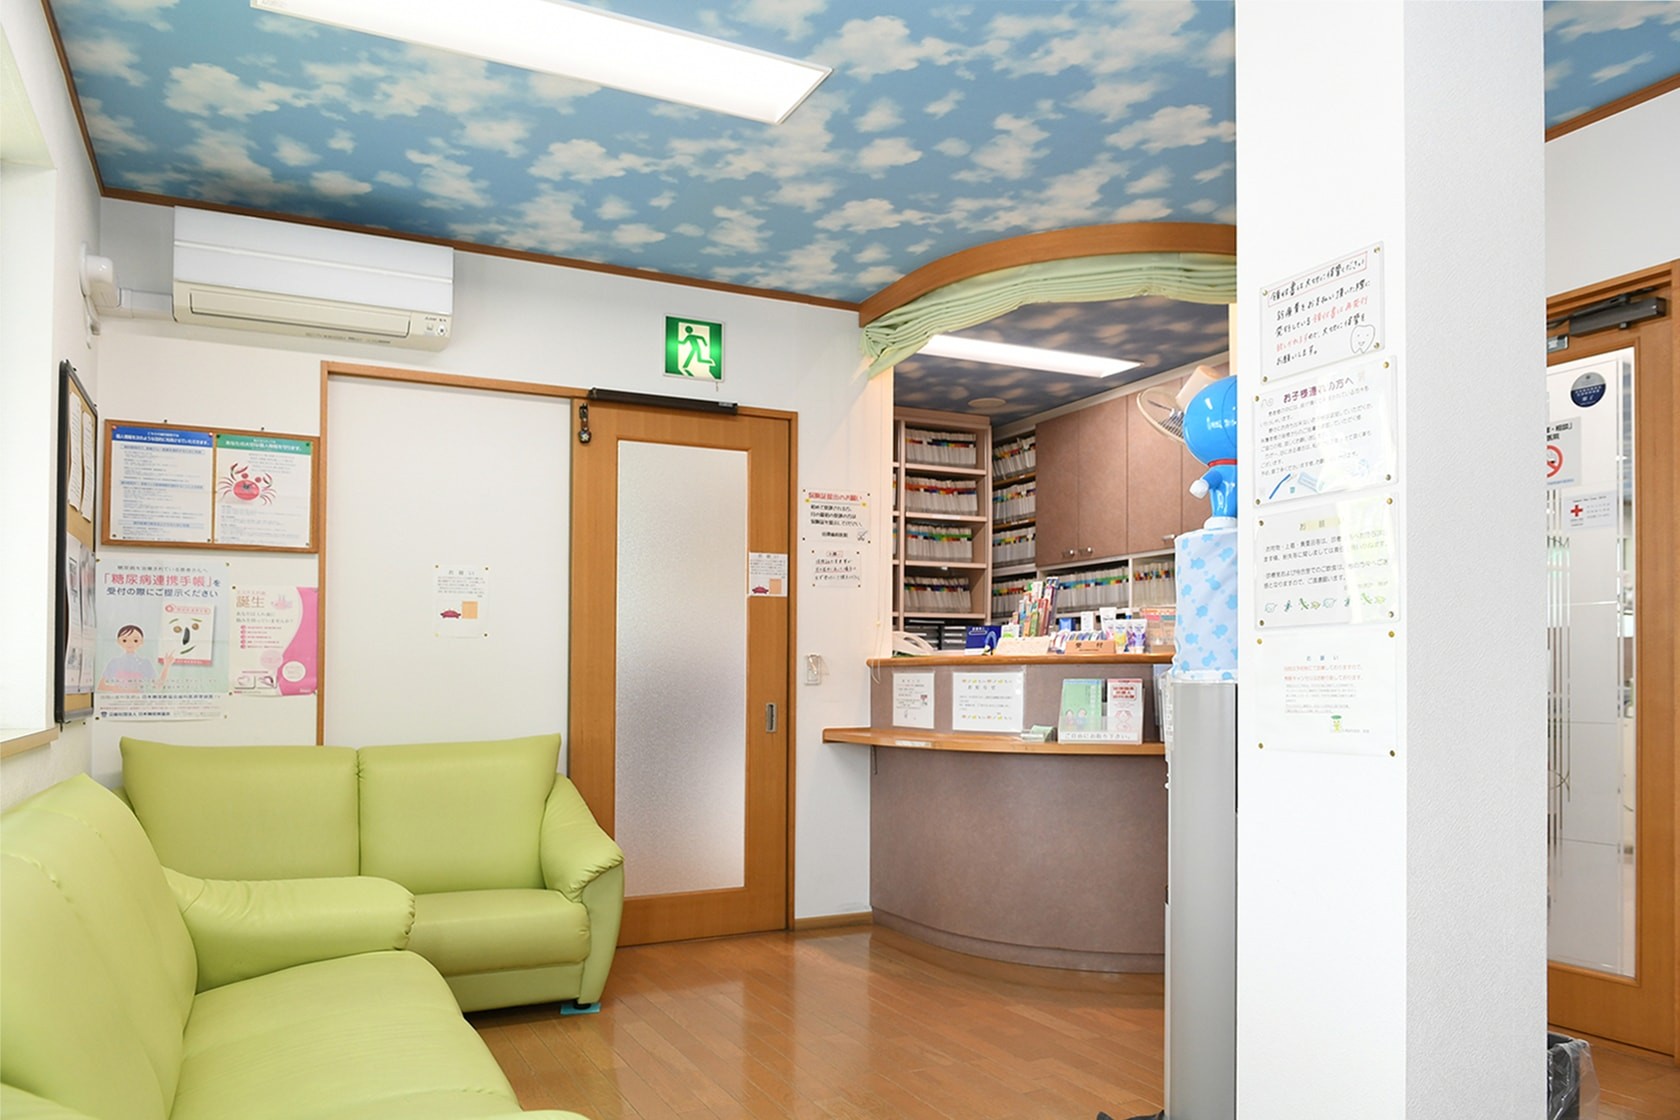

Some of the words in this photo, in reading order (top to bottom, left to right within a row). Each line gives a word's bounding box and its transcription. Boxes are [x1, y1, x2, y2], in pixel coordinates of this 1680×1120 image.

[1276, 345, 1318, 366] お願いします。
[1283, 377, 1355, 404] お子様連れの方へ
[104, 572, 221, 588] 「糖尿病連携手帳」を
[106, 586, 219, 598] 受付の際にご提示ください
[236, 595, 265, 609] 誕生
